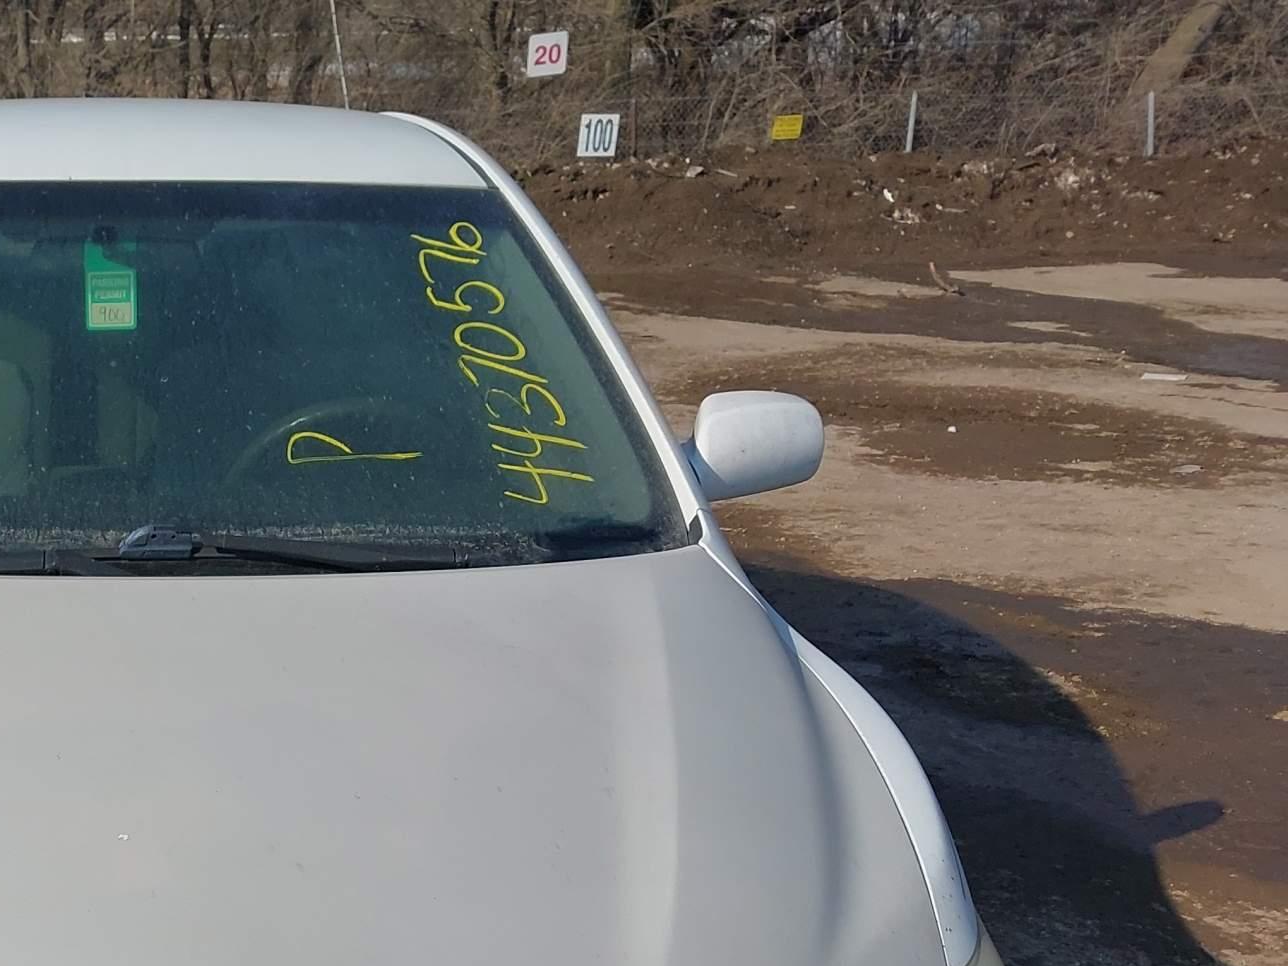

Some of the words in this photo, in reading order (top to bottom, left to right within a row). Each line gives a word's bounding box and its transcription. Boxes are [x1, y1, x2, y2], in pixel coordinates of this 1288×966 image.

[534, 43, 562, 66] 20
[584, 118, 614, 153] 100
[410, 221, 595, 505] 44370576
